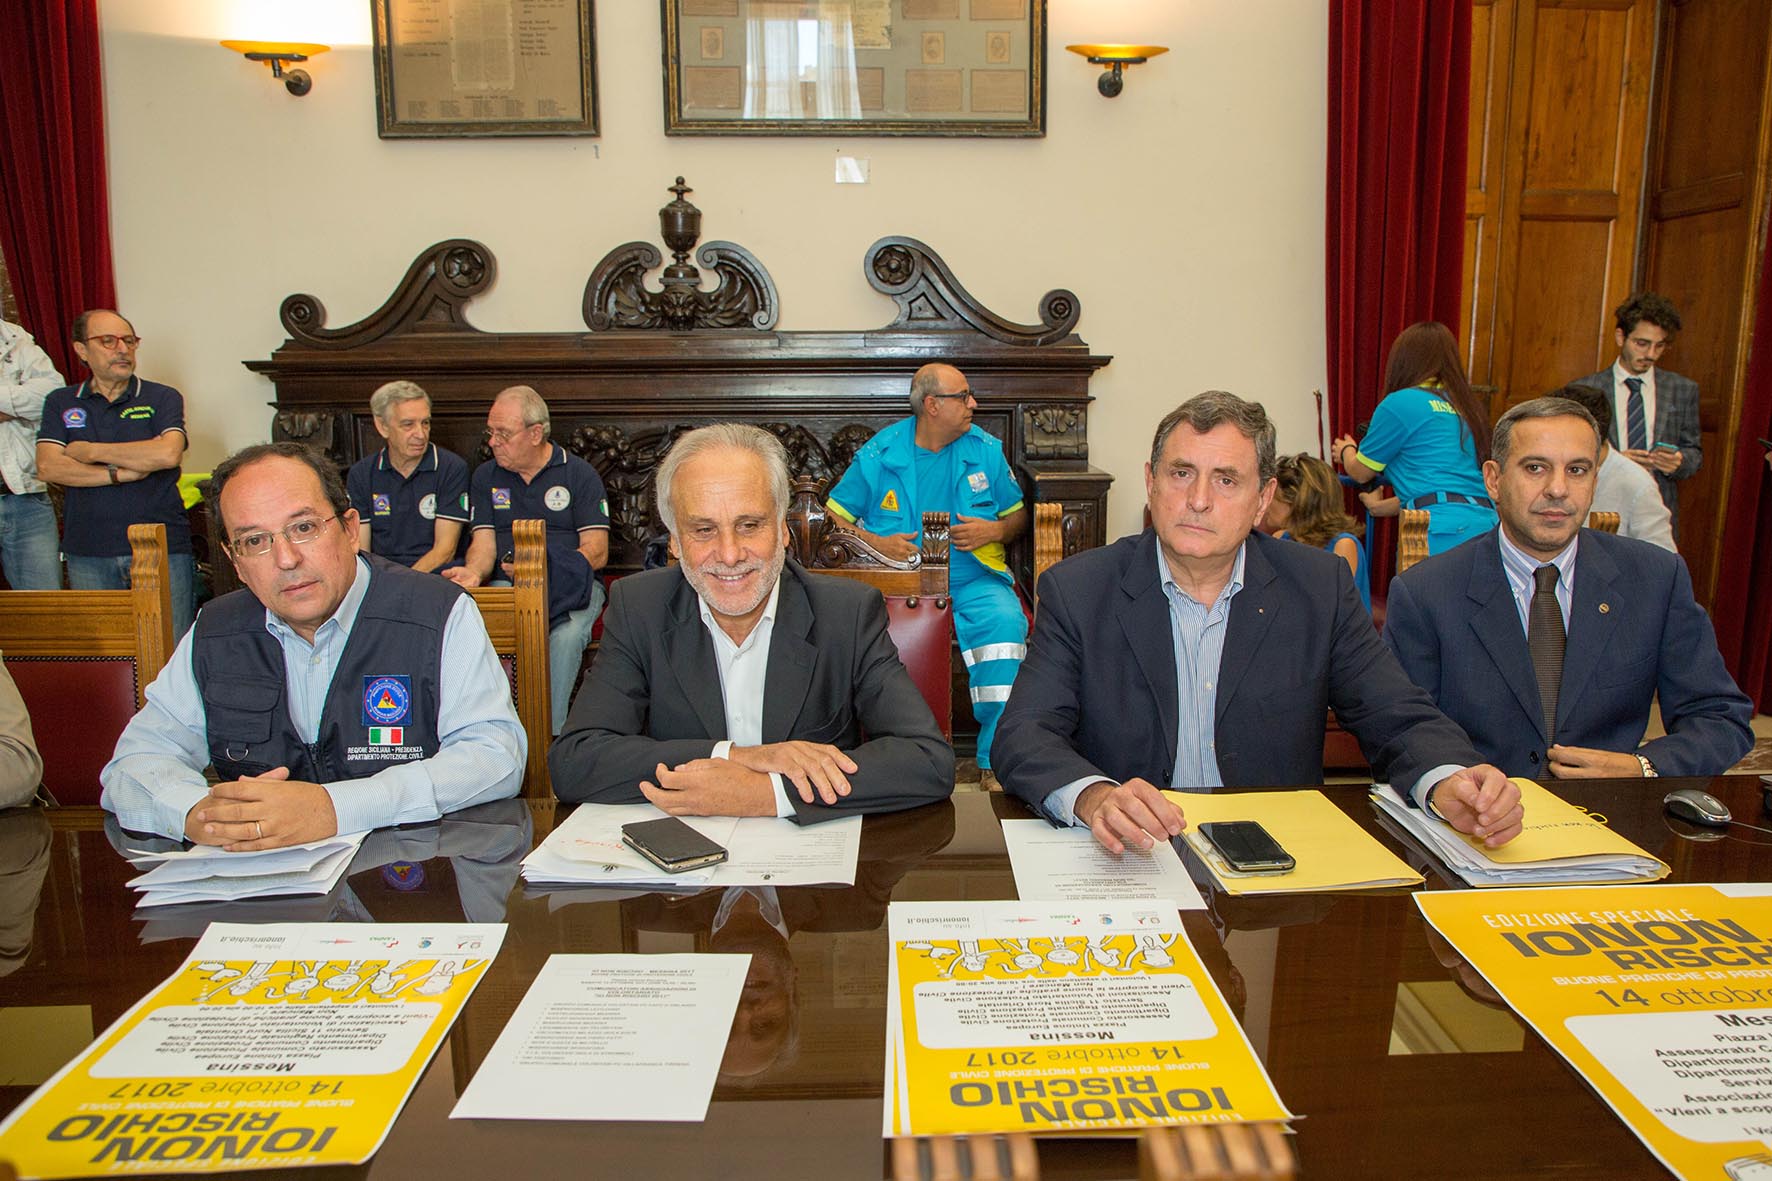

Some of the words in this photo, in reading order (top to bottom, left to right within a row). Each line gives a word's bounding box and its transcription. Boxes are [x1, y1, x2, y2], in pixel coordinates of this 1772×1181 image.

[1428, 400, 1456, 414] MISE
[1482, 910, 1589, 928] EDIZIONE
[1588, 908, 1701, 925] SPECIALE
[1602, 938, 1772, 970] RISCH
[1552, 974, 1617, 986] BUONE
[1618, 972, 1702, 984] PRATICHE
[1704, 971, 1728, 980] DI
[1594, 988, 1650, 1008] 14
[1029, 1031, 1115, 1041] Messina
[1713, 1034, 1768, 1042] Piazza
[1047, 1047, 1140, 1062] ottobre
[1151, 1046, 1184, 1060] 14
[1655, 1046, 1757, 1057] Assessorato
[967, 1051, 1036, 1067] 2017
[1662, 1056, 1770, 1068] Dipartimento
[206, 1062, 296, 1071] Messina
[994, 1067, 1076, 1076] PROTEZIONE
[1096, 1064, 1160, 1073] PRATICHE
[1164, 1062, 1210, 1070] BUONE
[1673, 1067, 1772, 1079] Dipartiment
[200, 1081, 302, 1094] ottobre
[308, 1080, 344, 1095] 14
[1721, 1078, 1772, 1088] Serviz
[108, 1082, 194, 1098] 2017
[949, 1075, 1160, 1107] RISCHIO
[1684, 1092, 1772, 1103] Associazio
[1731, 1104, 1772, 1115] scop
[46, 1112, 282, 1141] RISCHIO
